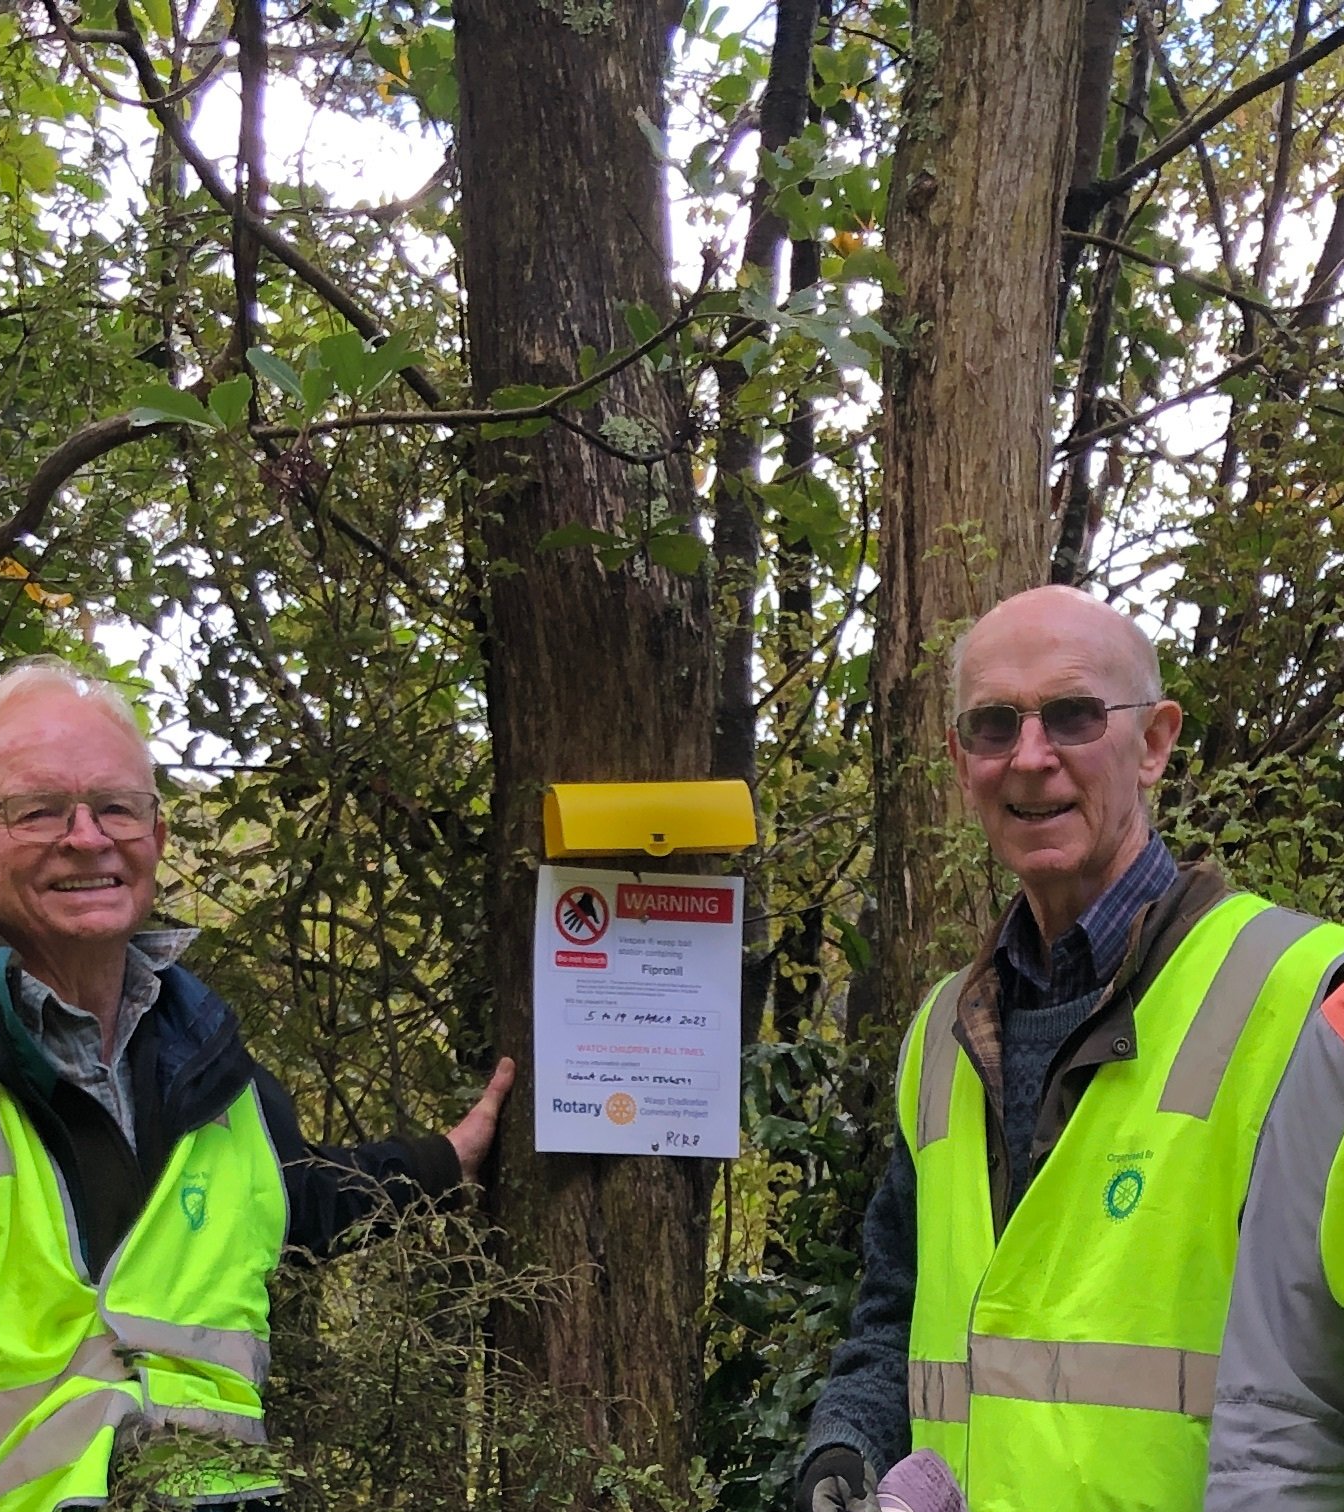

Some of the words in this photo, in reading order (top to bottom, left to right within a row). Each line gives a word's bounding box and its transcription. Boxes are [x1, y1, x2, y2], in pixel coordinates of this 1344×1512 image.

[624, 893, 719, 914] WARNING
[642, 964, 683, 976] Fipronil
[585, 1011, 596, 1021] 5
[679, 1015, 706, 1027] 2023
[576, 1044, 607, 1053] WATCH
[609, 1046, 650, 1054] CHILDREN
[651, 1047, 663, 1055] AT
[679, 1048, 704, 1056] TIMES
[552, 1099, 602, 1117] Rotary
[640, 1109, 681, 1118] Community
[683, 1110, 709, 1119] Project
